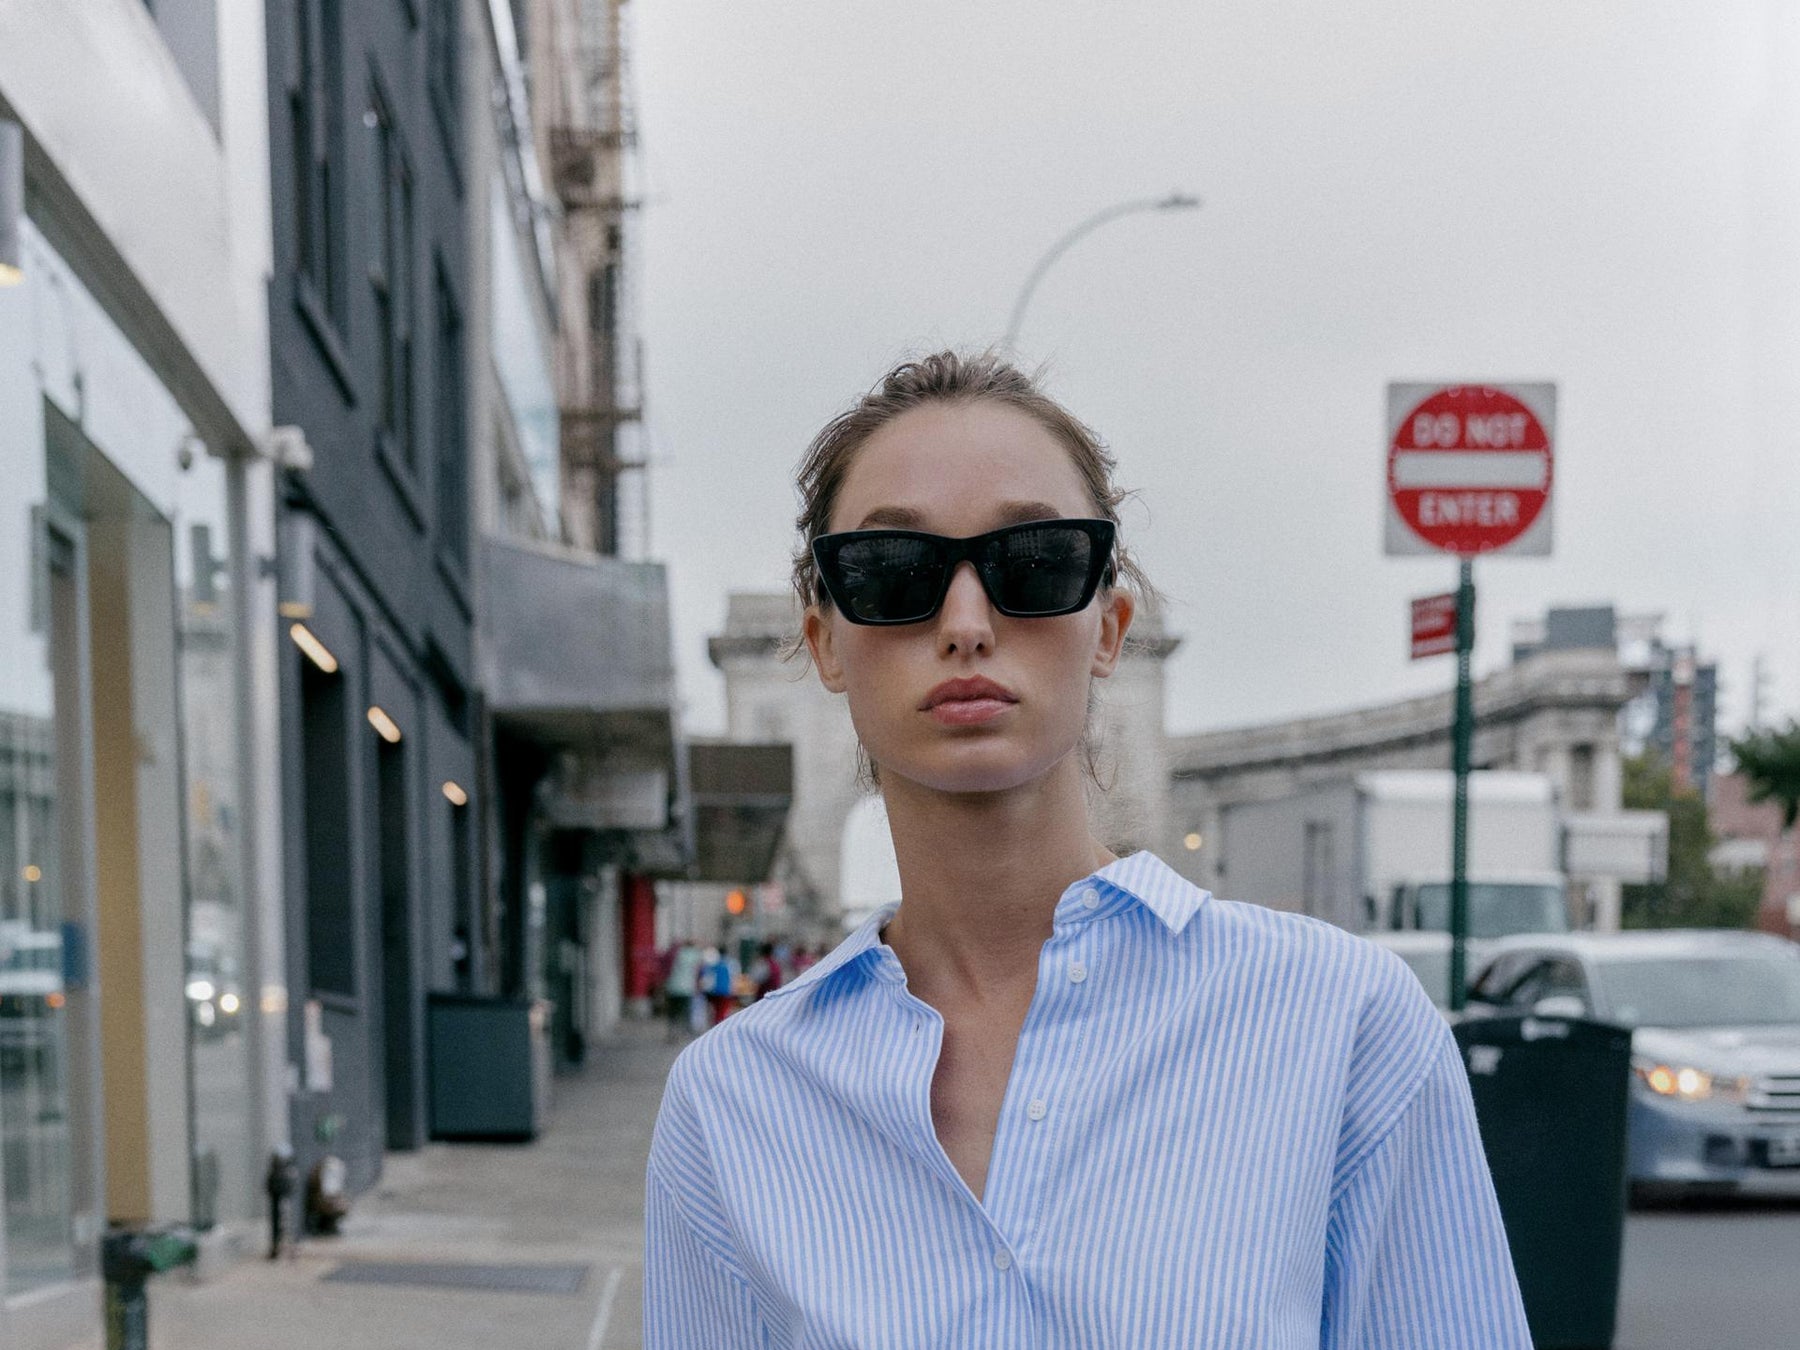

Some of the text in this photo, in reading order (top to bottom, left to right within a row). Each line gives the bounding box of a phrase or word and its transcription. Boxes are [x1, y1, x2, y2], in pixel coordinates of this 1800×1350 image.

[1413, 411, 1528, 447] DO NOT
[1418, 492, 1520, 526] ENTER
